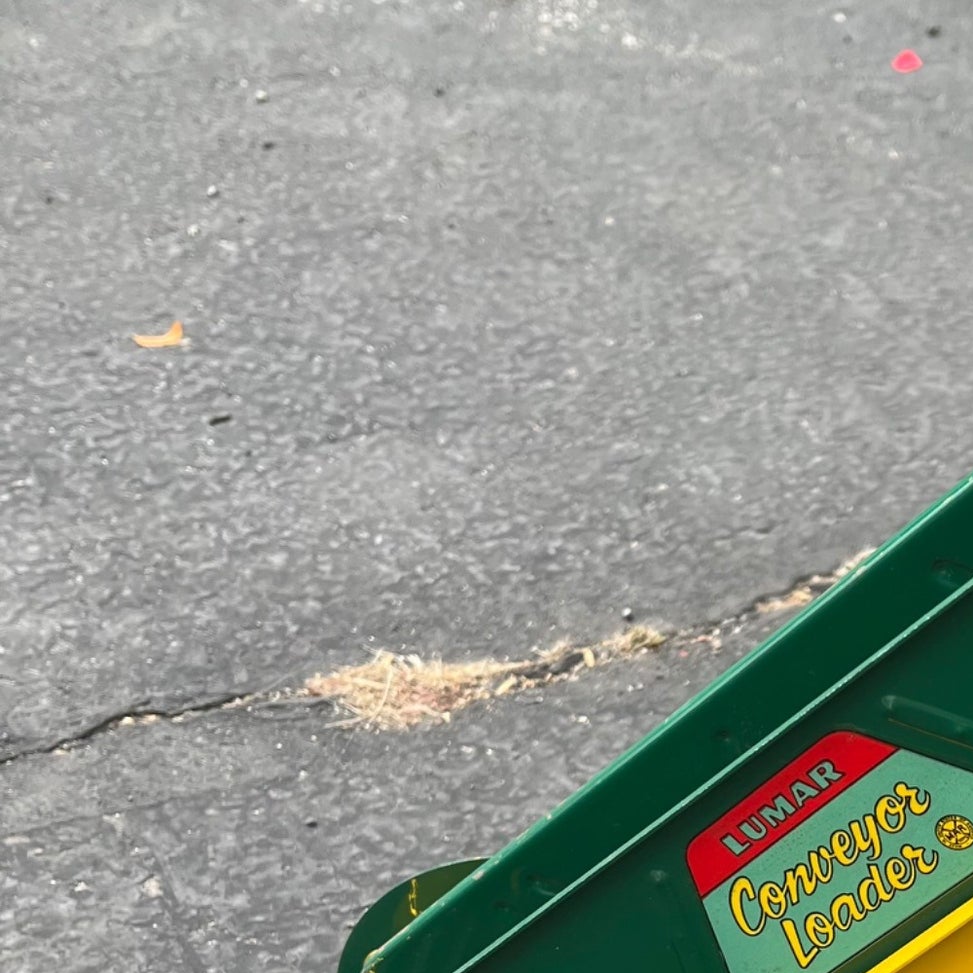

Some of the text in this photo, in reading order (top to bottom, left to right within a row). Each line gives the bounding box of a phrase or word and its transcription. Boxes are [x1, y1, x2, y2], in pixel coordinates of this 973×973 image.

[721, 760, 844, 856] LUMAR
[729, 782, 931, 936] Conveyor
[781, 845, 938, 968] Loader
